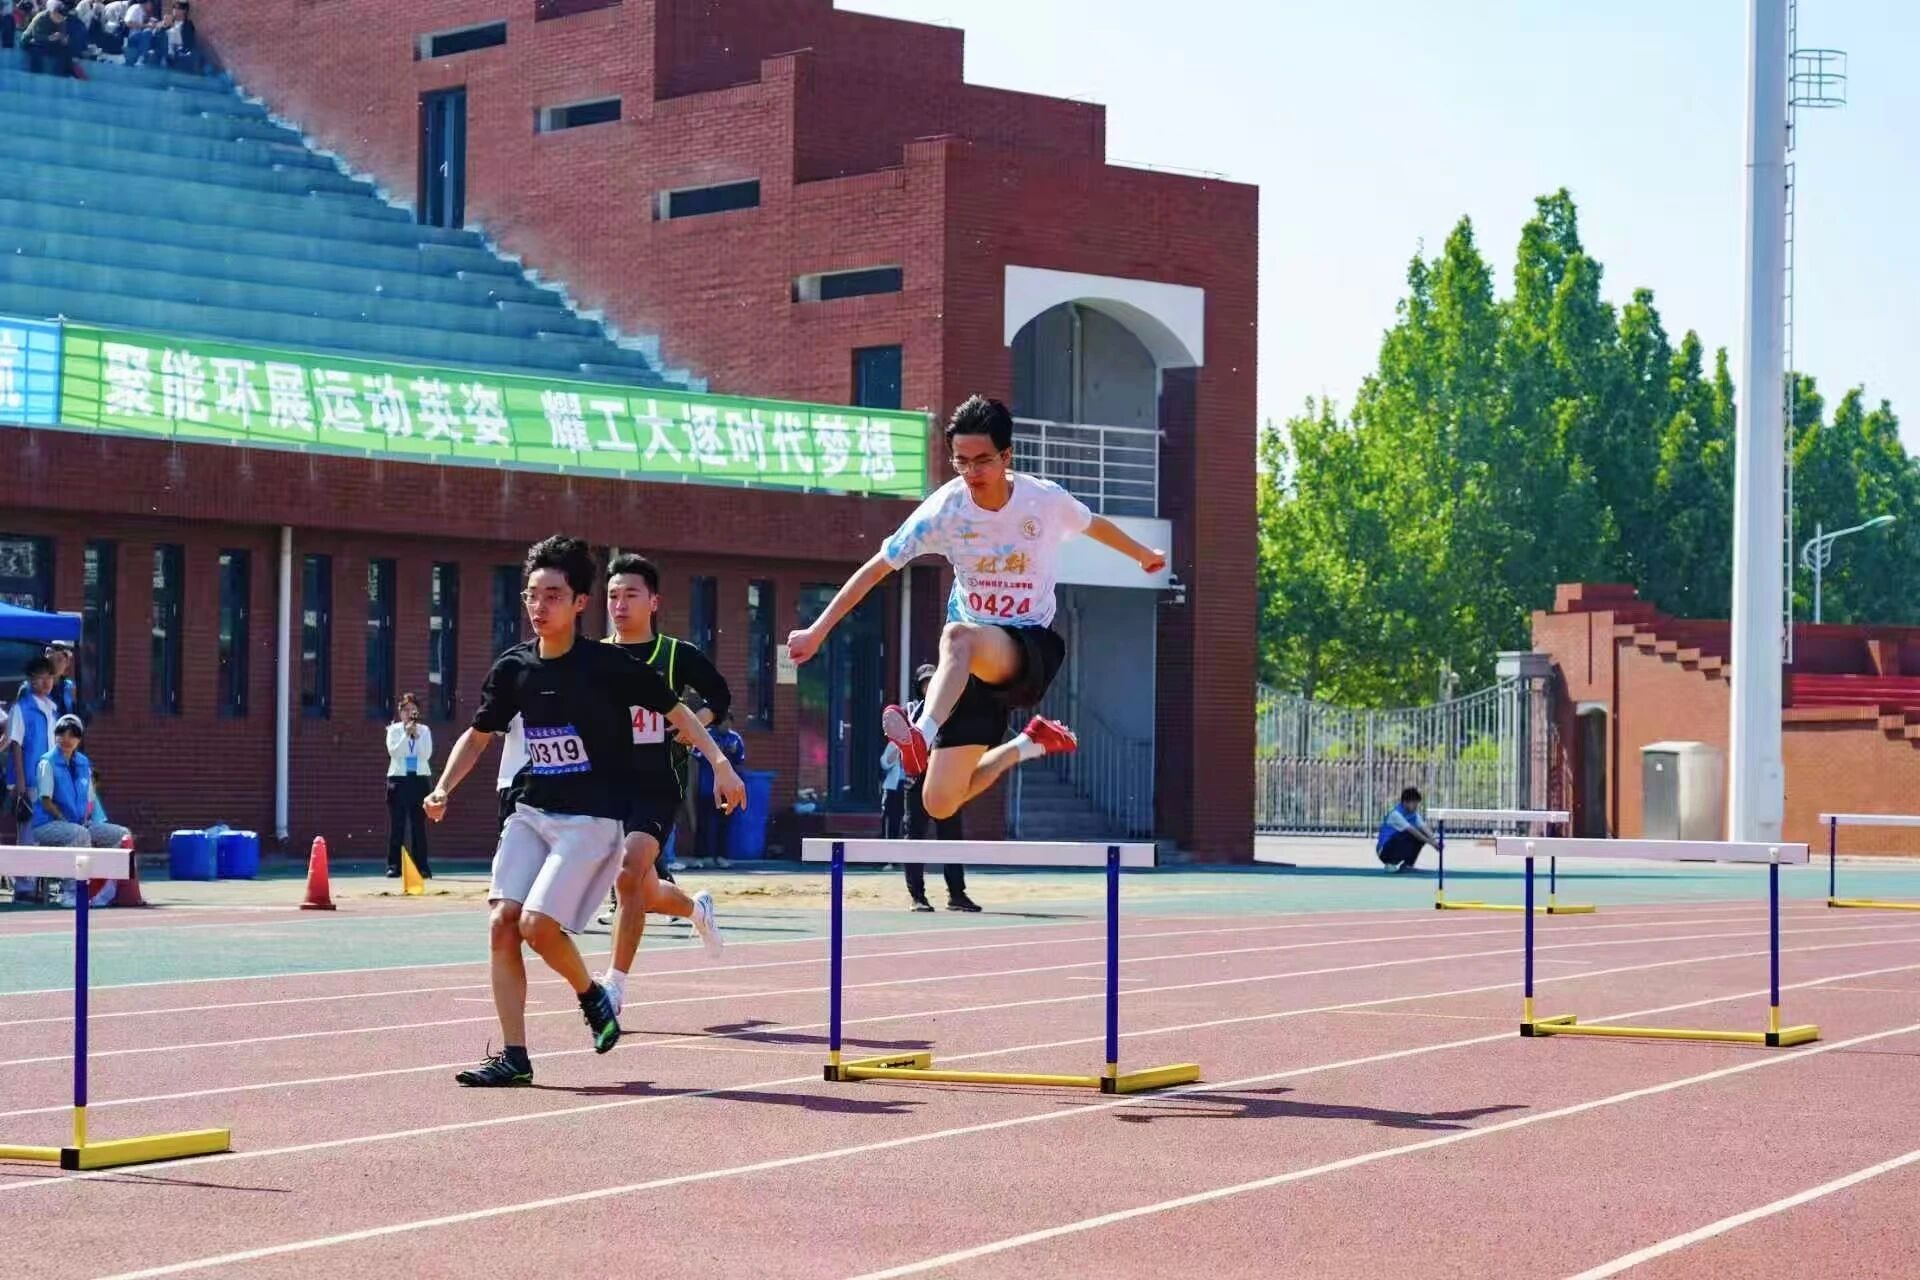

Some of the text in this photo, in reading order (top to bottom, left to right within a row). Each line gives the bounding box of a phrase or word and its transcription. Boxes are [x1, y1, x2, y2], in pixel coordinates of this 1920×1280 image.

[102, 340, 509, 448] 聚能环展运动英姿
[540, 388, 896, 480] 耀工大逐时代梦想
[968, 592, 1032, 618] 0424
[528, 738, 580, 764] 0319
